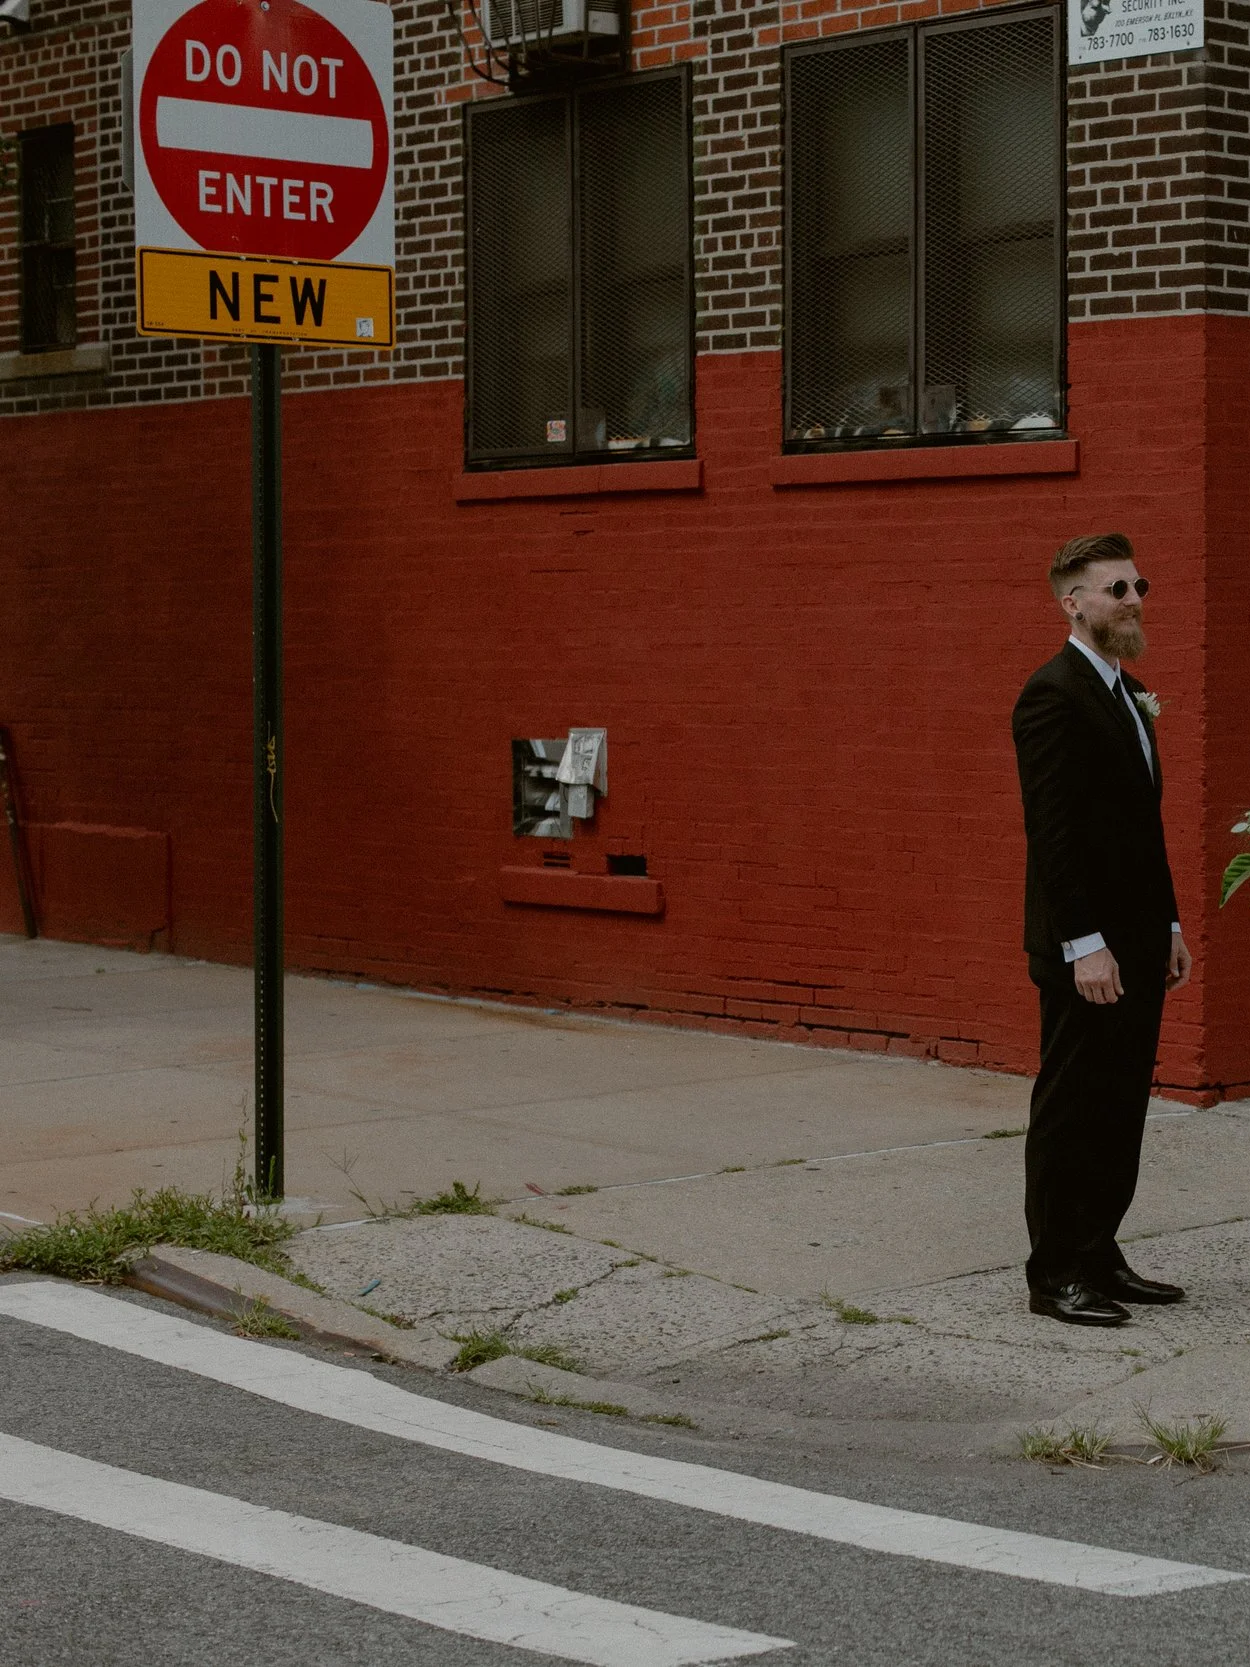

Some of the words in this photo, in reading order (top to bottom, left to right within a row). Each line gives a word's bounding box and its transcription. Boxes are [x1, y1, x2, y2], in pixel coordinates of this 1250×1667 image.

[185, 39, 242, 87] DO
[262, 50, 344, 99] NOT
[198, 170, 334, 223] ENTER
[209, 270, 327, 327] NEW
